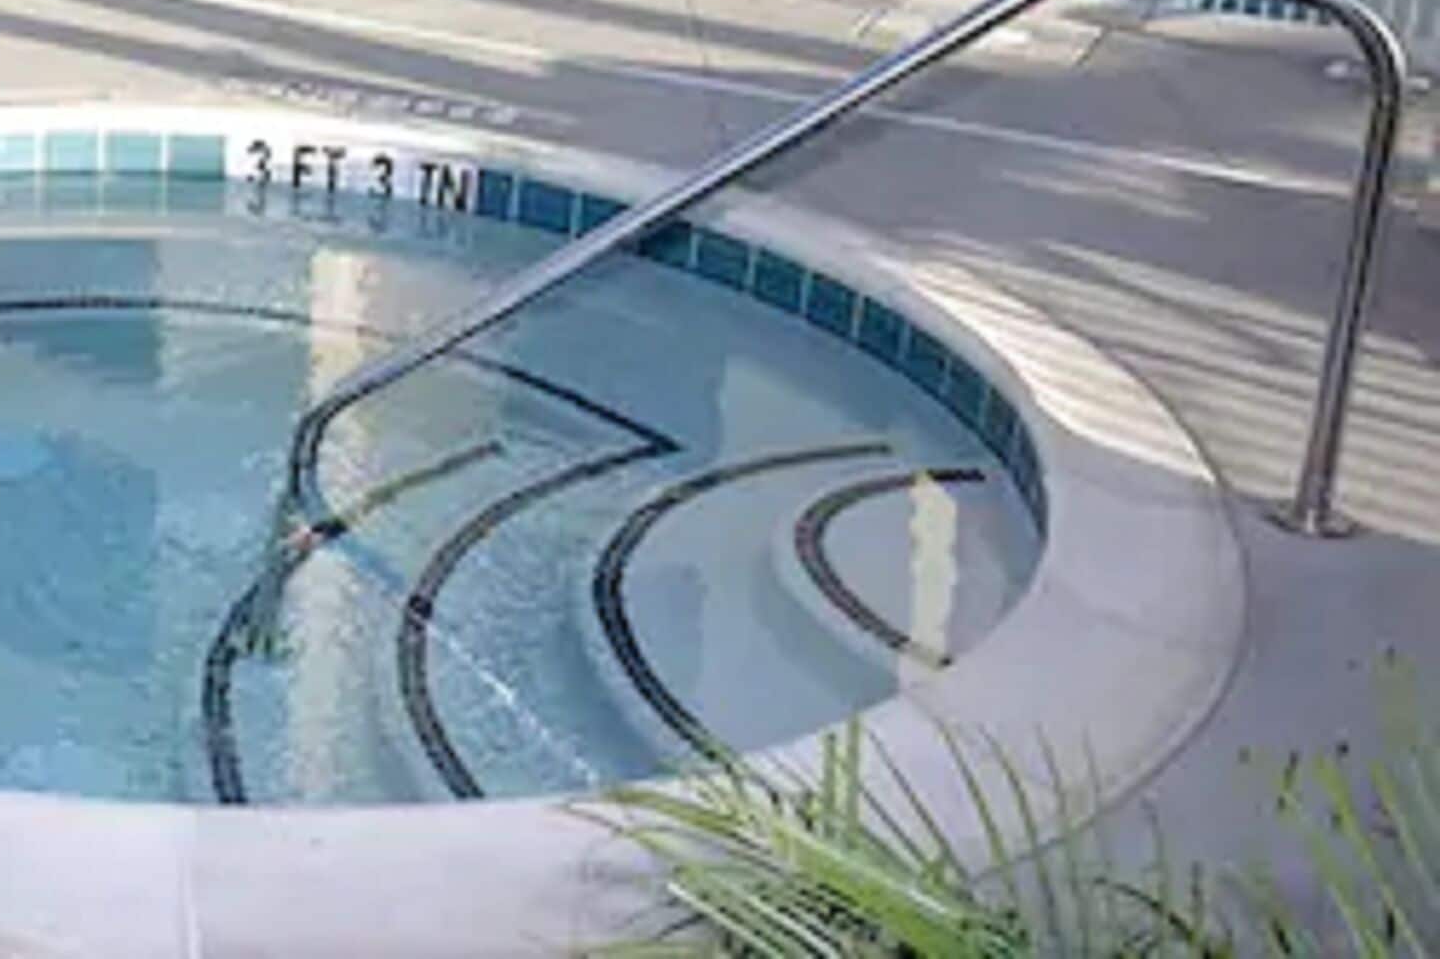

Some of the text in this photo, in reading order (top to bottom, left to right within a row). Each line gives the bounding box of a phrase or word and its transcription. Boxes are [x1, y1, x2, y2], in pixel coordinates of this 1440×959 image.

[246, 139, 469, 212] 3 FT 3 IN
